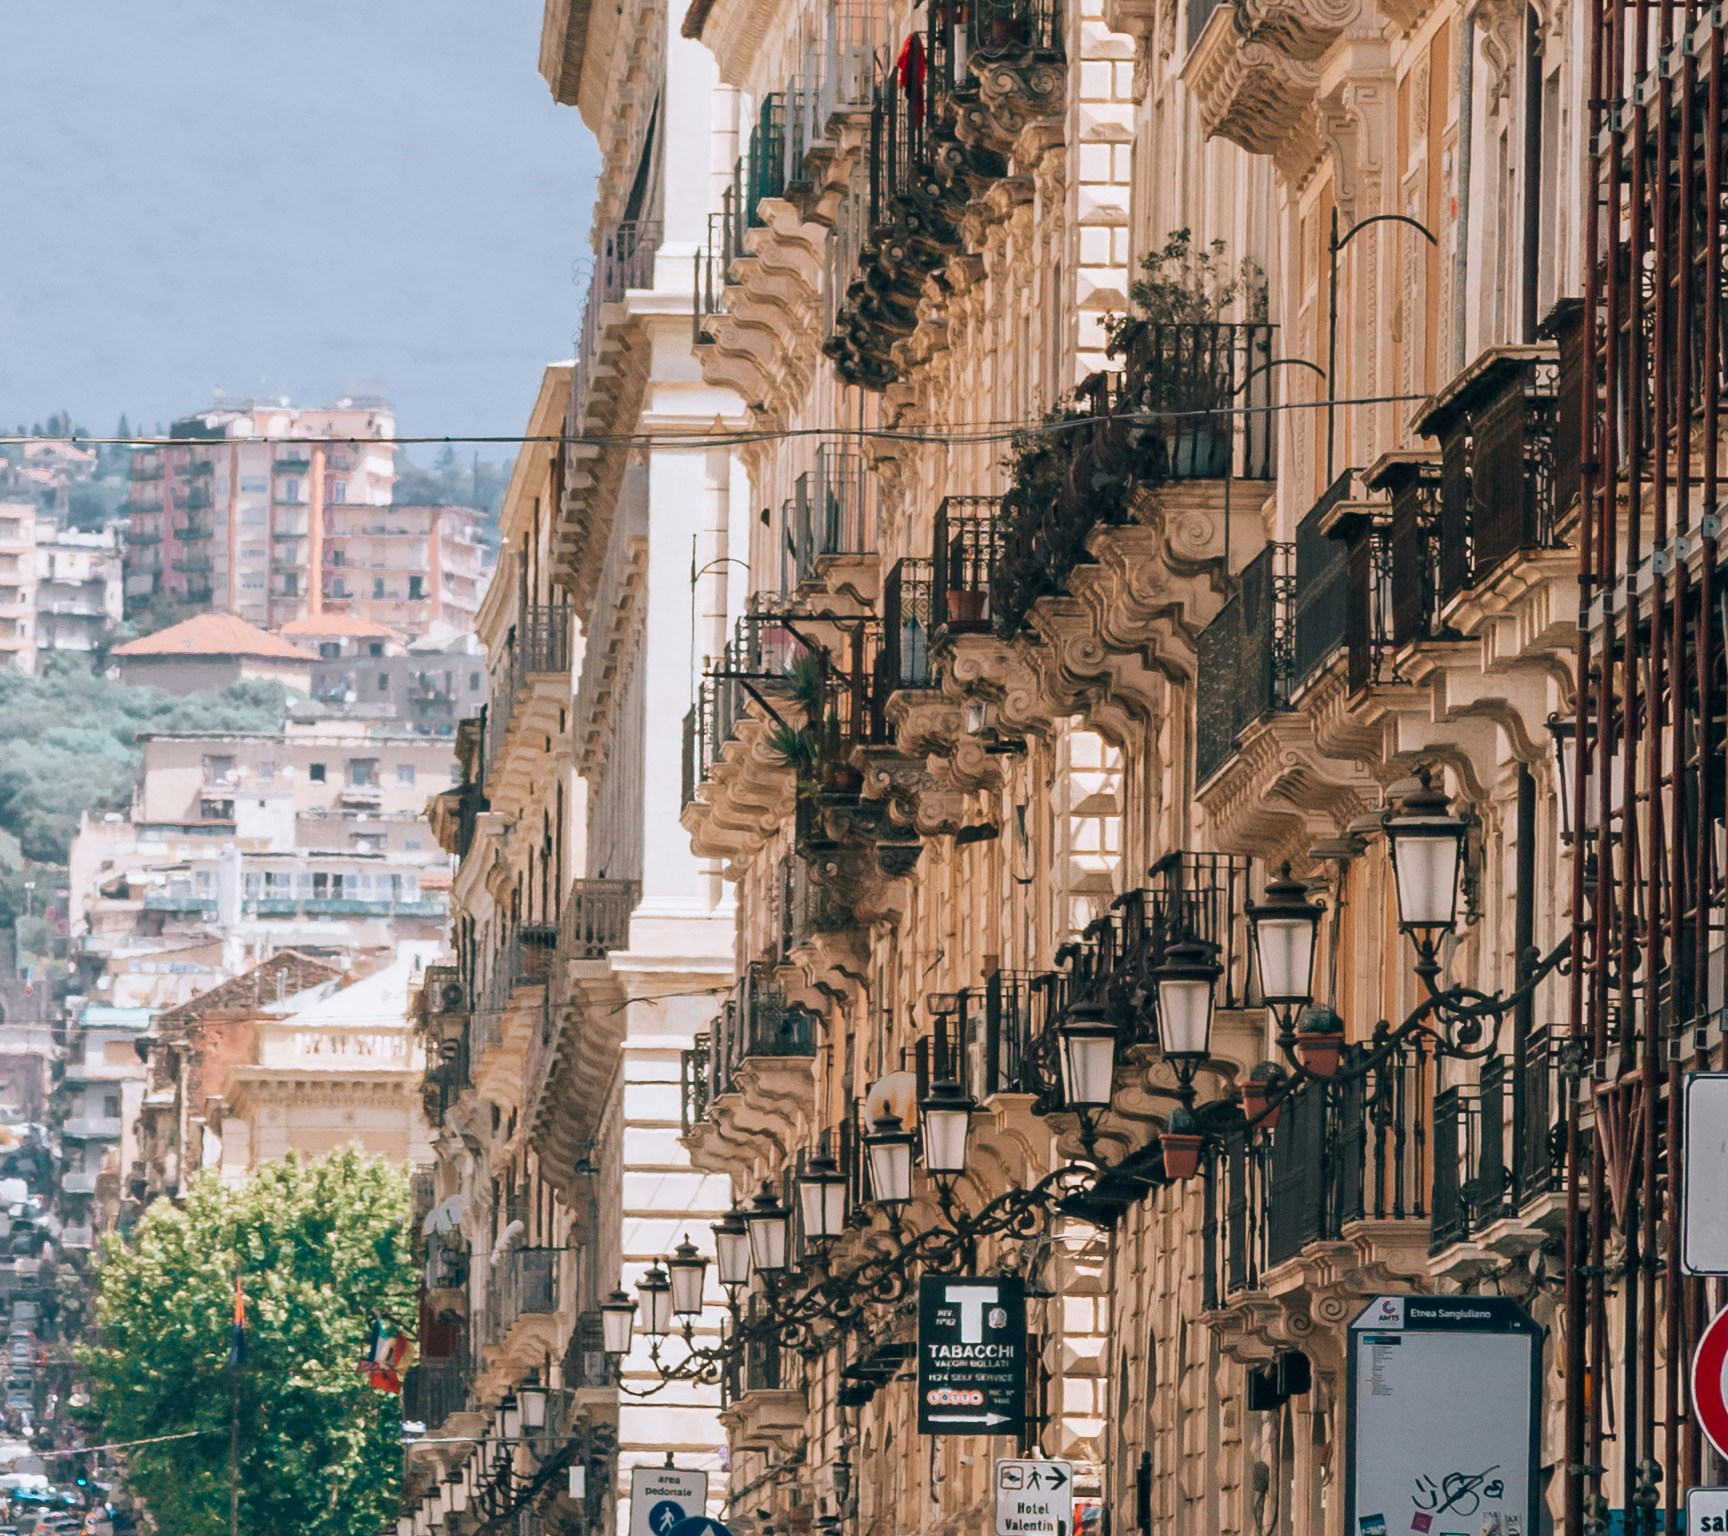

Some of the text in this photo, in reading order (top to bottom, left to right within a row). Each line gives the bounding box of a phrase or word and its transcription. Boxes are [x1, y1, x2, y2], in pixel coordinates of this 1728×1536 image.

[945, 1286, 998, 1343] T
[1378, 1314, 1400, 1322] AMTS
[1410, 1308, 1492, 1321] Etnea Sangiuliano
[928, 1344, 1014, 1359] TABACCHI
[934, 1359, 1010, 1368] VALORI BOLLATI
[951, 1373, 973, 1382] SELF
[974, 1373, 1014, 1383] SERVICE
[658, 1476, 681, 1485] area
[645, 1487, 693, 1497] pedonale
[1017, 1501, 1050, 1515] Hotel
